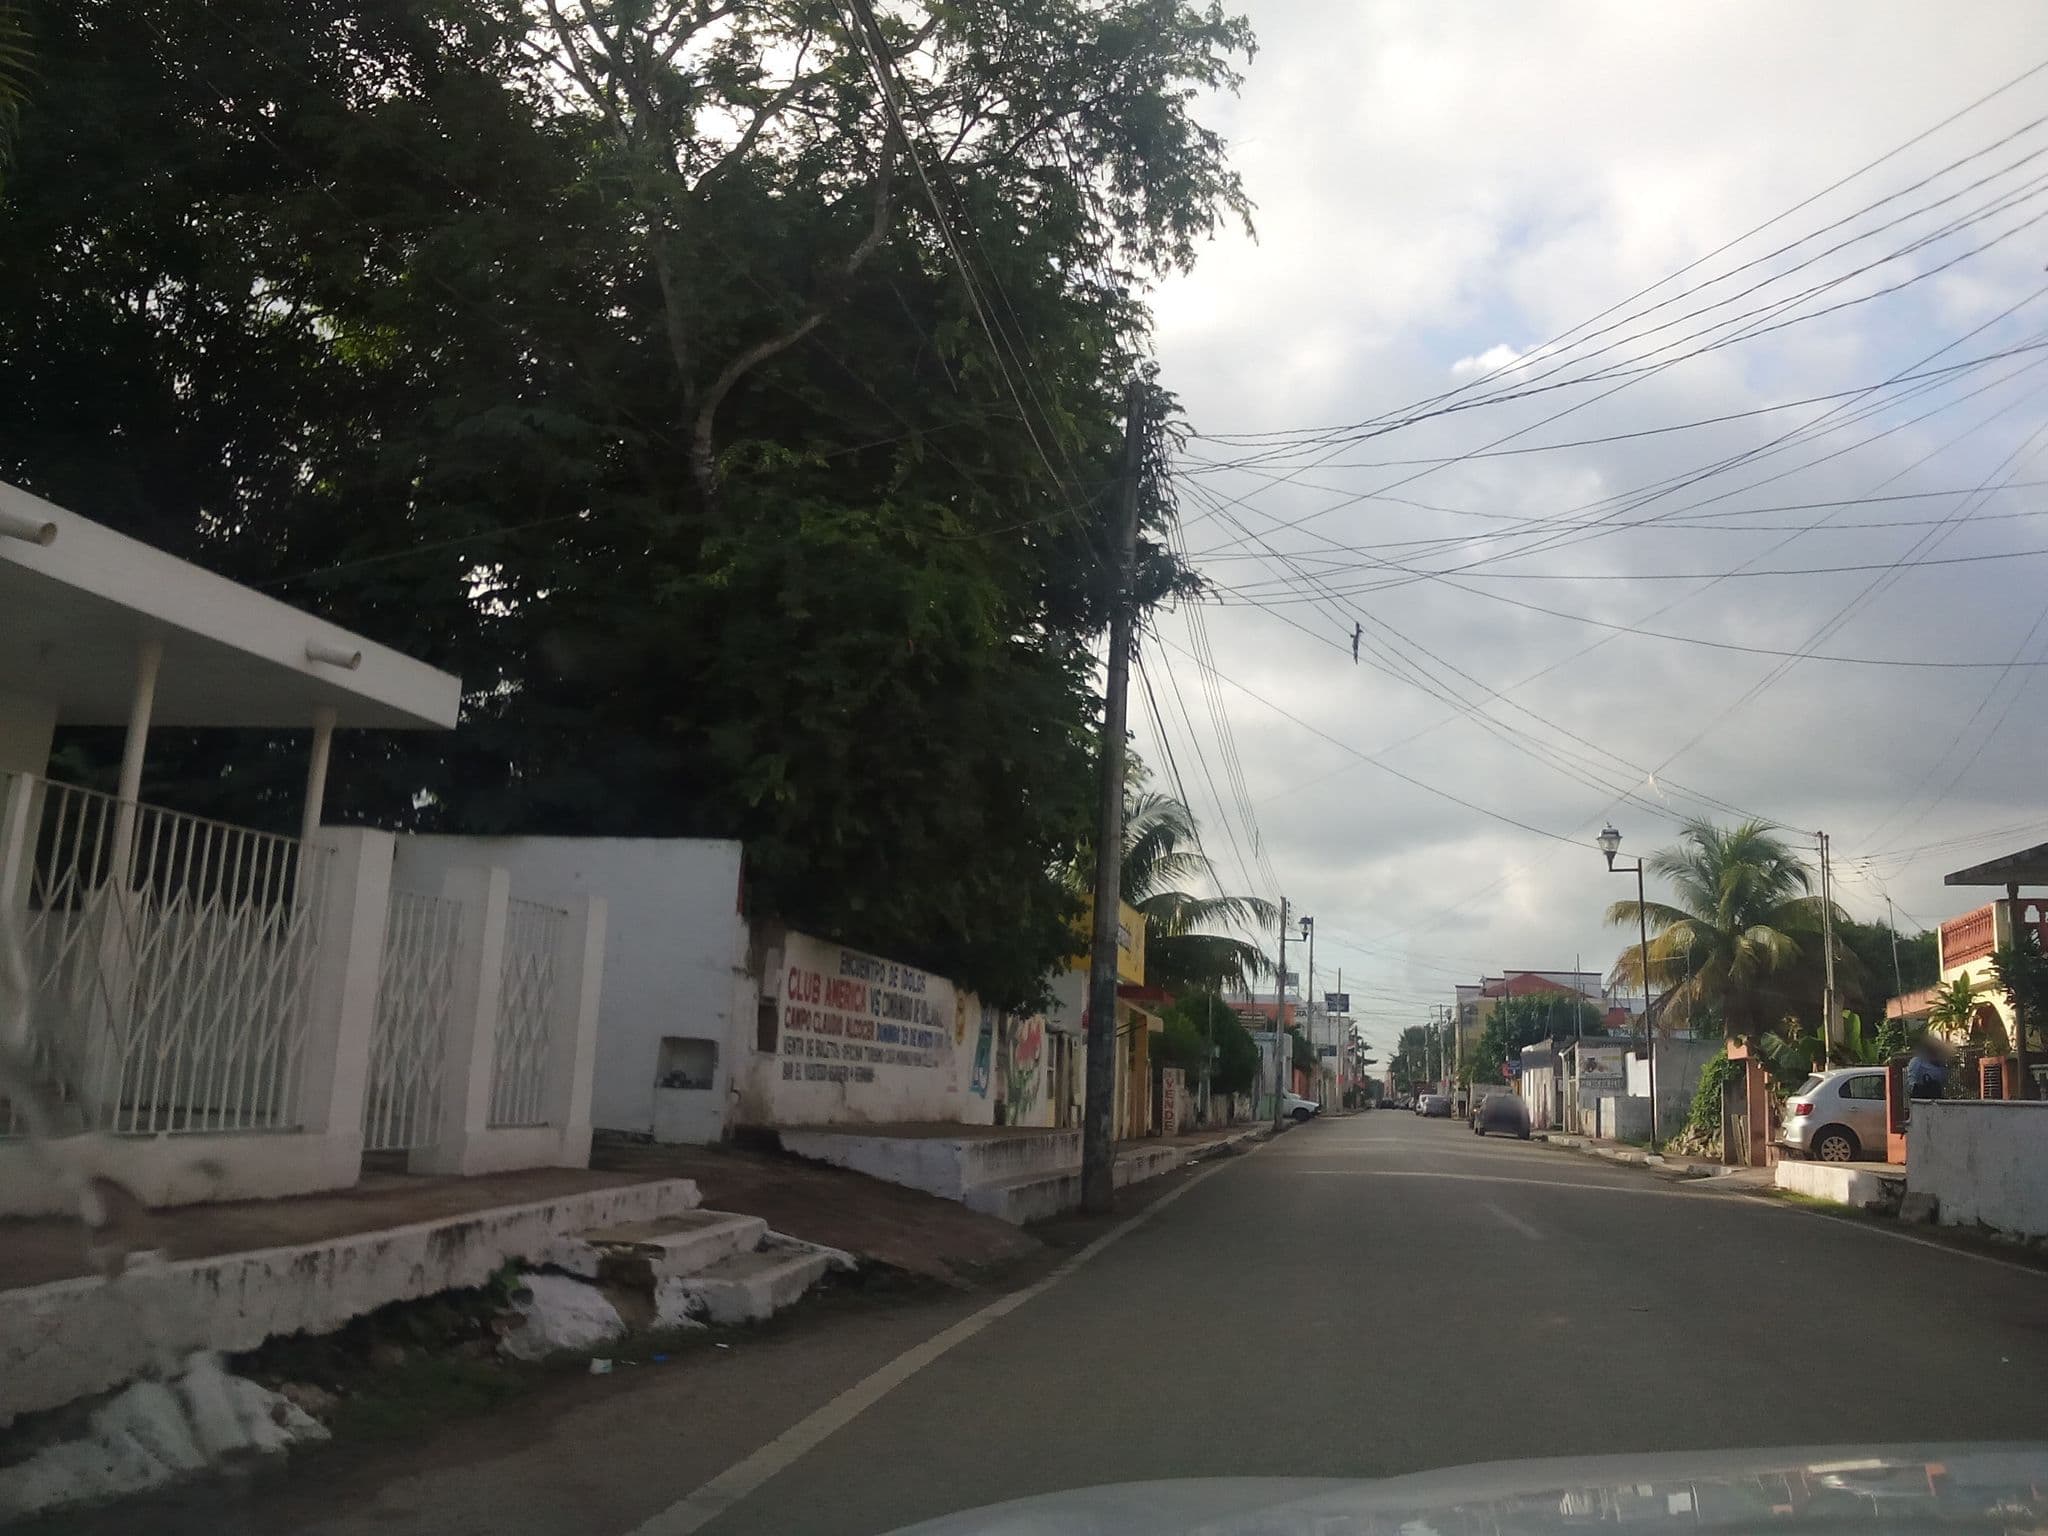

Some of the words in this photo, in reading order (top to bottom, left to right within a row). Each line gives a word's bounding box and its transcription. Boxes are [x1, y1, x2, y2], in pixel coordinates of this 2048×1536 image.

[788, 966, 821, 1005] CLUB
[825, 977, 867, 1014] AMERICA
[784, 1005, 811, 1031] CAMPO
[1164, 1078, 1174, 1131] VENDE
